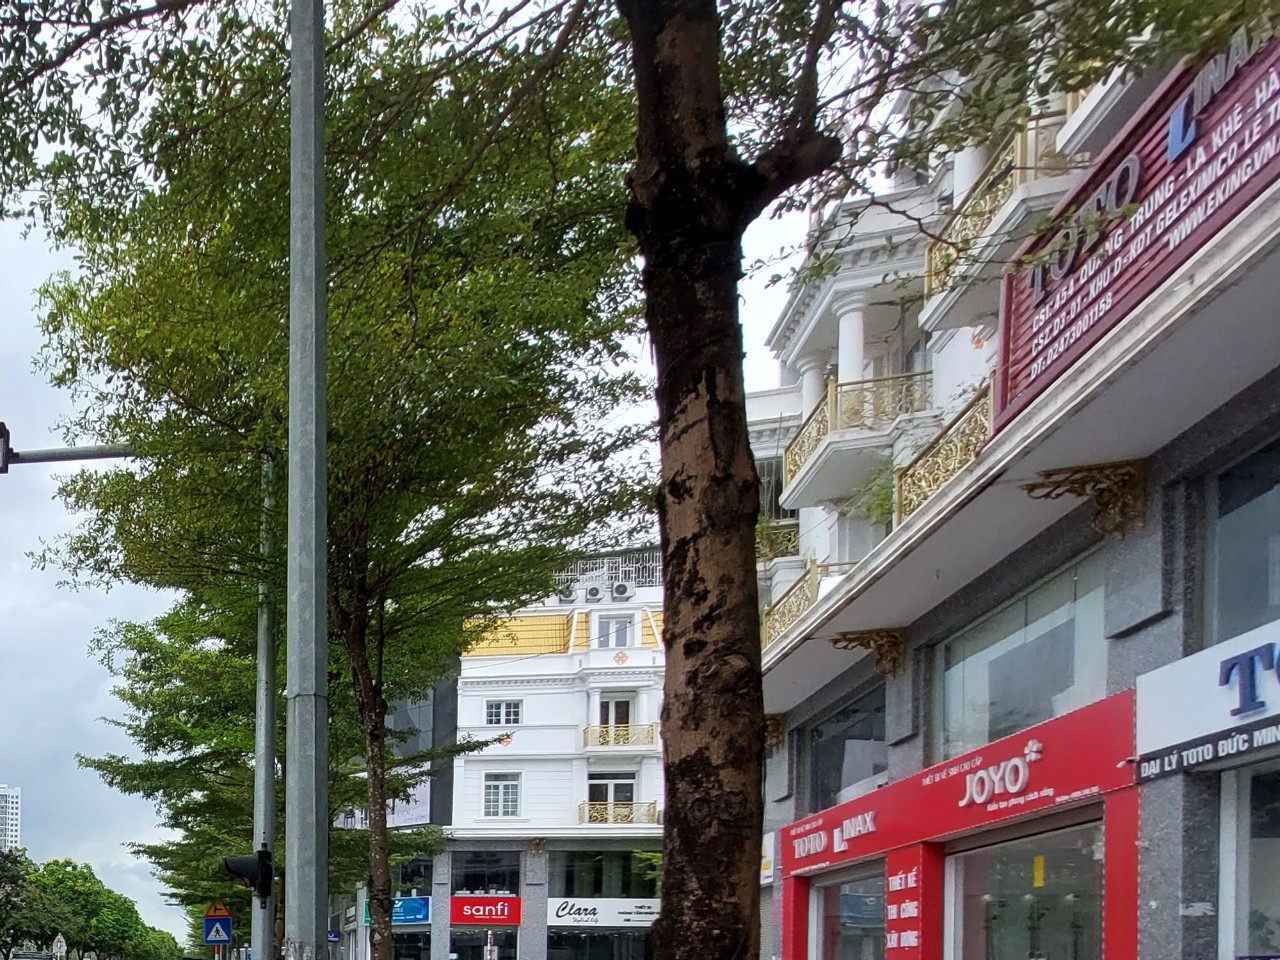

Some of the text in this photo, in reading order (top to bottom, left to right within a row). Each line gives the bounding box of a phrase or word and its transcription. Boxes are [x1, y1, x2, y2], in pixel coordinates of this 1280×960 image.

[1053, 278, 1074, 311] 454
[1130, 175, 1175, 233] TRUNG
[1187, 146, 1206, 179] LA
[1211, 102, 1243, 150] KHÊ
[1089, 271, 1110, 302] KHU
[1156, 142, 1238, 234] GELEXIMICO
[1140, 759, 1160, 778] ĐẠI
[1164, 750, 1179, 772] LÝ
[1182, 743, 1213, 767] TOTO
[1218, 732, 1249, 757] ĐỨC
[958, 757, 1029, 807] JOYO
[793, 830, 827, 859] TOTO
[463, 901, 508, 916] sanfi
[555, 900, 599, 918] Clara
